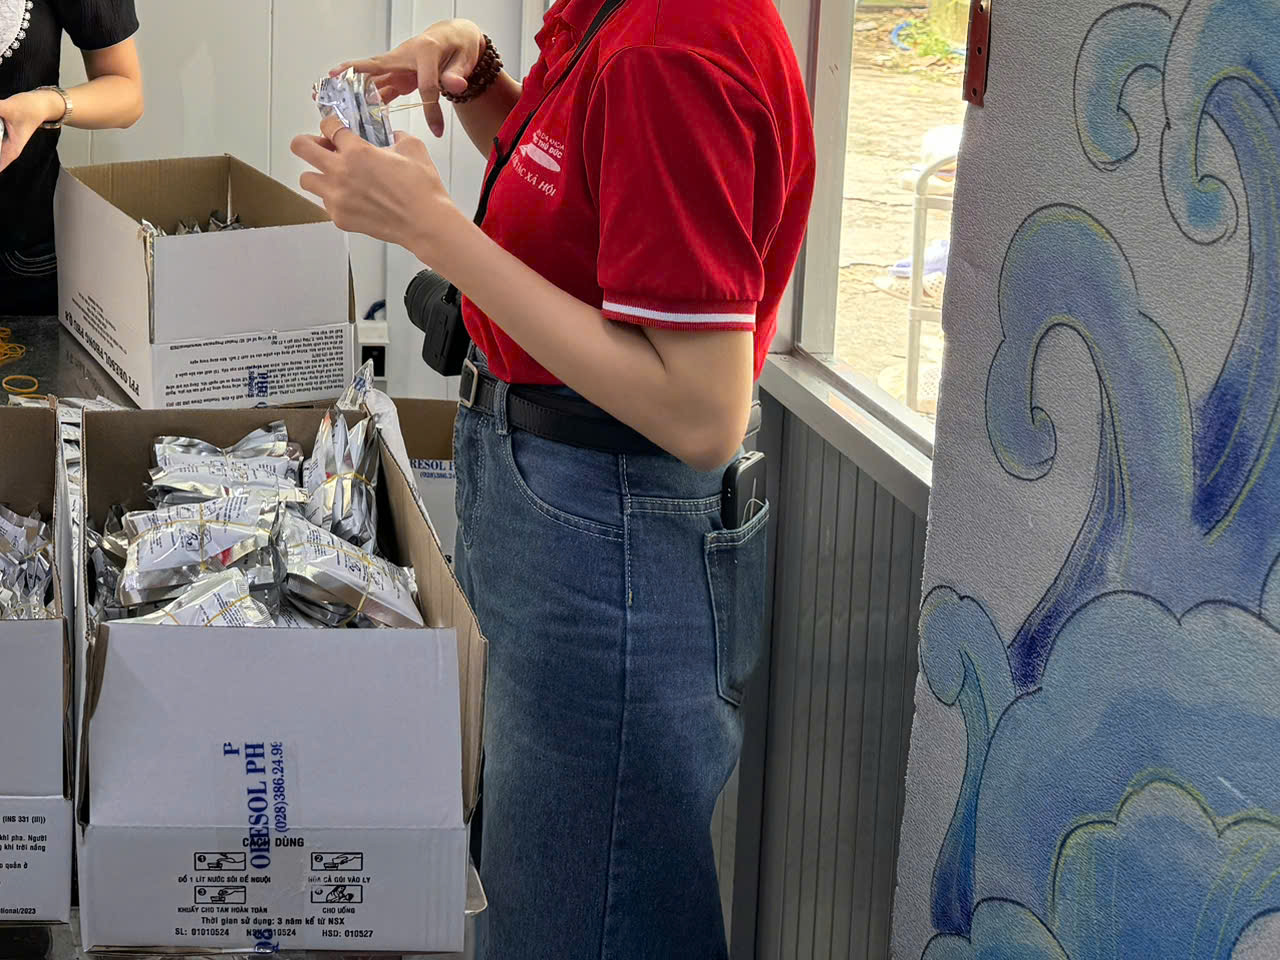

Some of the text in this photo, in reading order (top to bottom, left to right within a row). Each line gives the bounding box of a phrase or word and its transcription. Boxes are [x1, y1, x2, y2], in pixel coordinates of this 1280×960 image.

[538, 181, 556, 196] HỘI
[410, 460, 446, 471] RESOL
[2, 815, 17, 823] (INS
[28, 834, 47, 842] Người
[275, 835, 305, 847] DÙNG
[178, 874, 188, 883] ĐỔ
[207, 875, 225, 883] NƯỚC
[240, 874, 248, 882] ĐỂ
[251, 875, 271, 884] NGUỘI
[323, 874, 332, 882] CẢ
[347, 875, 360, 883] VÀO
[177, 905, 199, 913] KHUẤY
[338, 905, 355, 914] UỐNG
[201, 916, 218, 924] Thời
[221, 917, 238, 925] gian
[241, 916, 250, 924] sử
[253, 917, 275, 926] dụng:
[285, 917, 302, 925] năm
[305, 916, 315, 925] kể
[317, 917, 326, 925] từ
[328, 917, 345, 925] NSX
[175, 927, 188, 936] SL:
[191, 928, 229, 936] 01010524
[322, 929, 342, 937] HSD:
[344, 930, 374, 938] 010527
